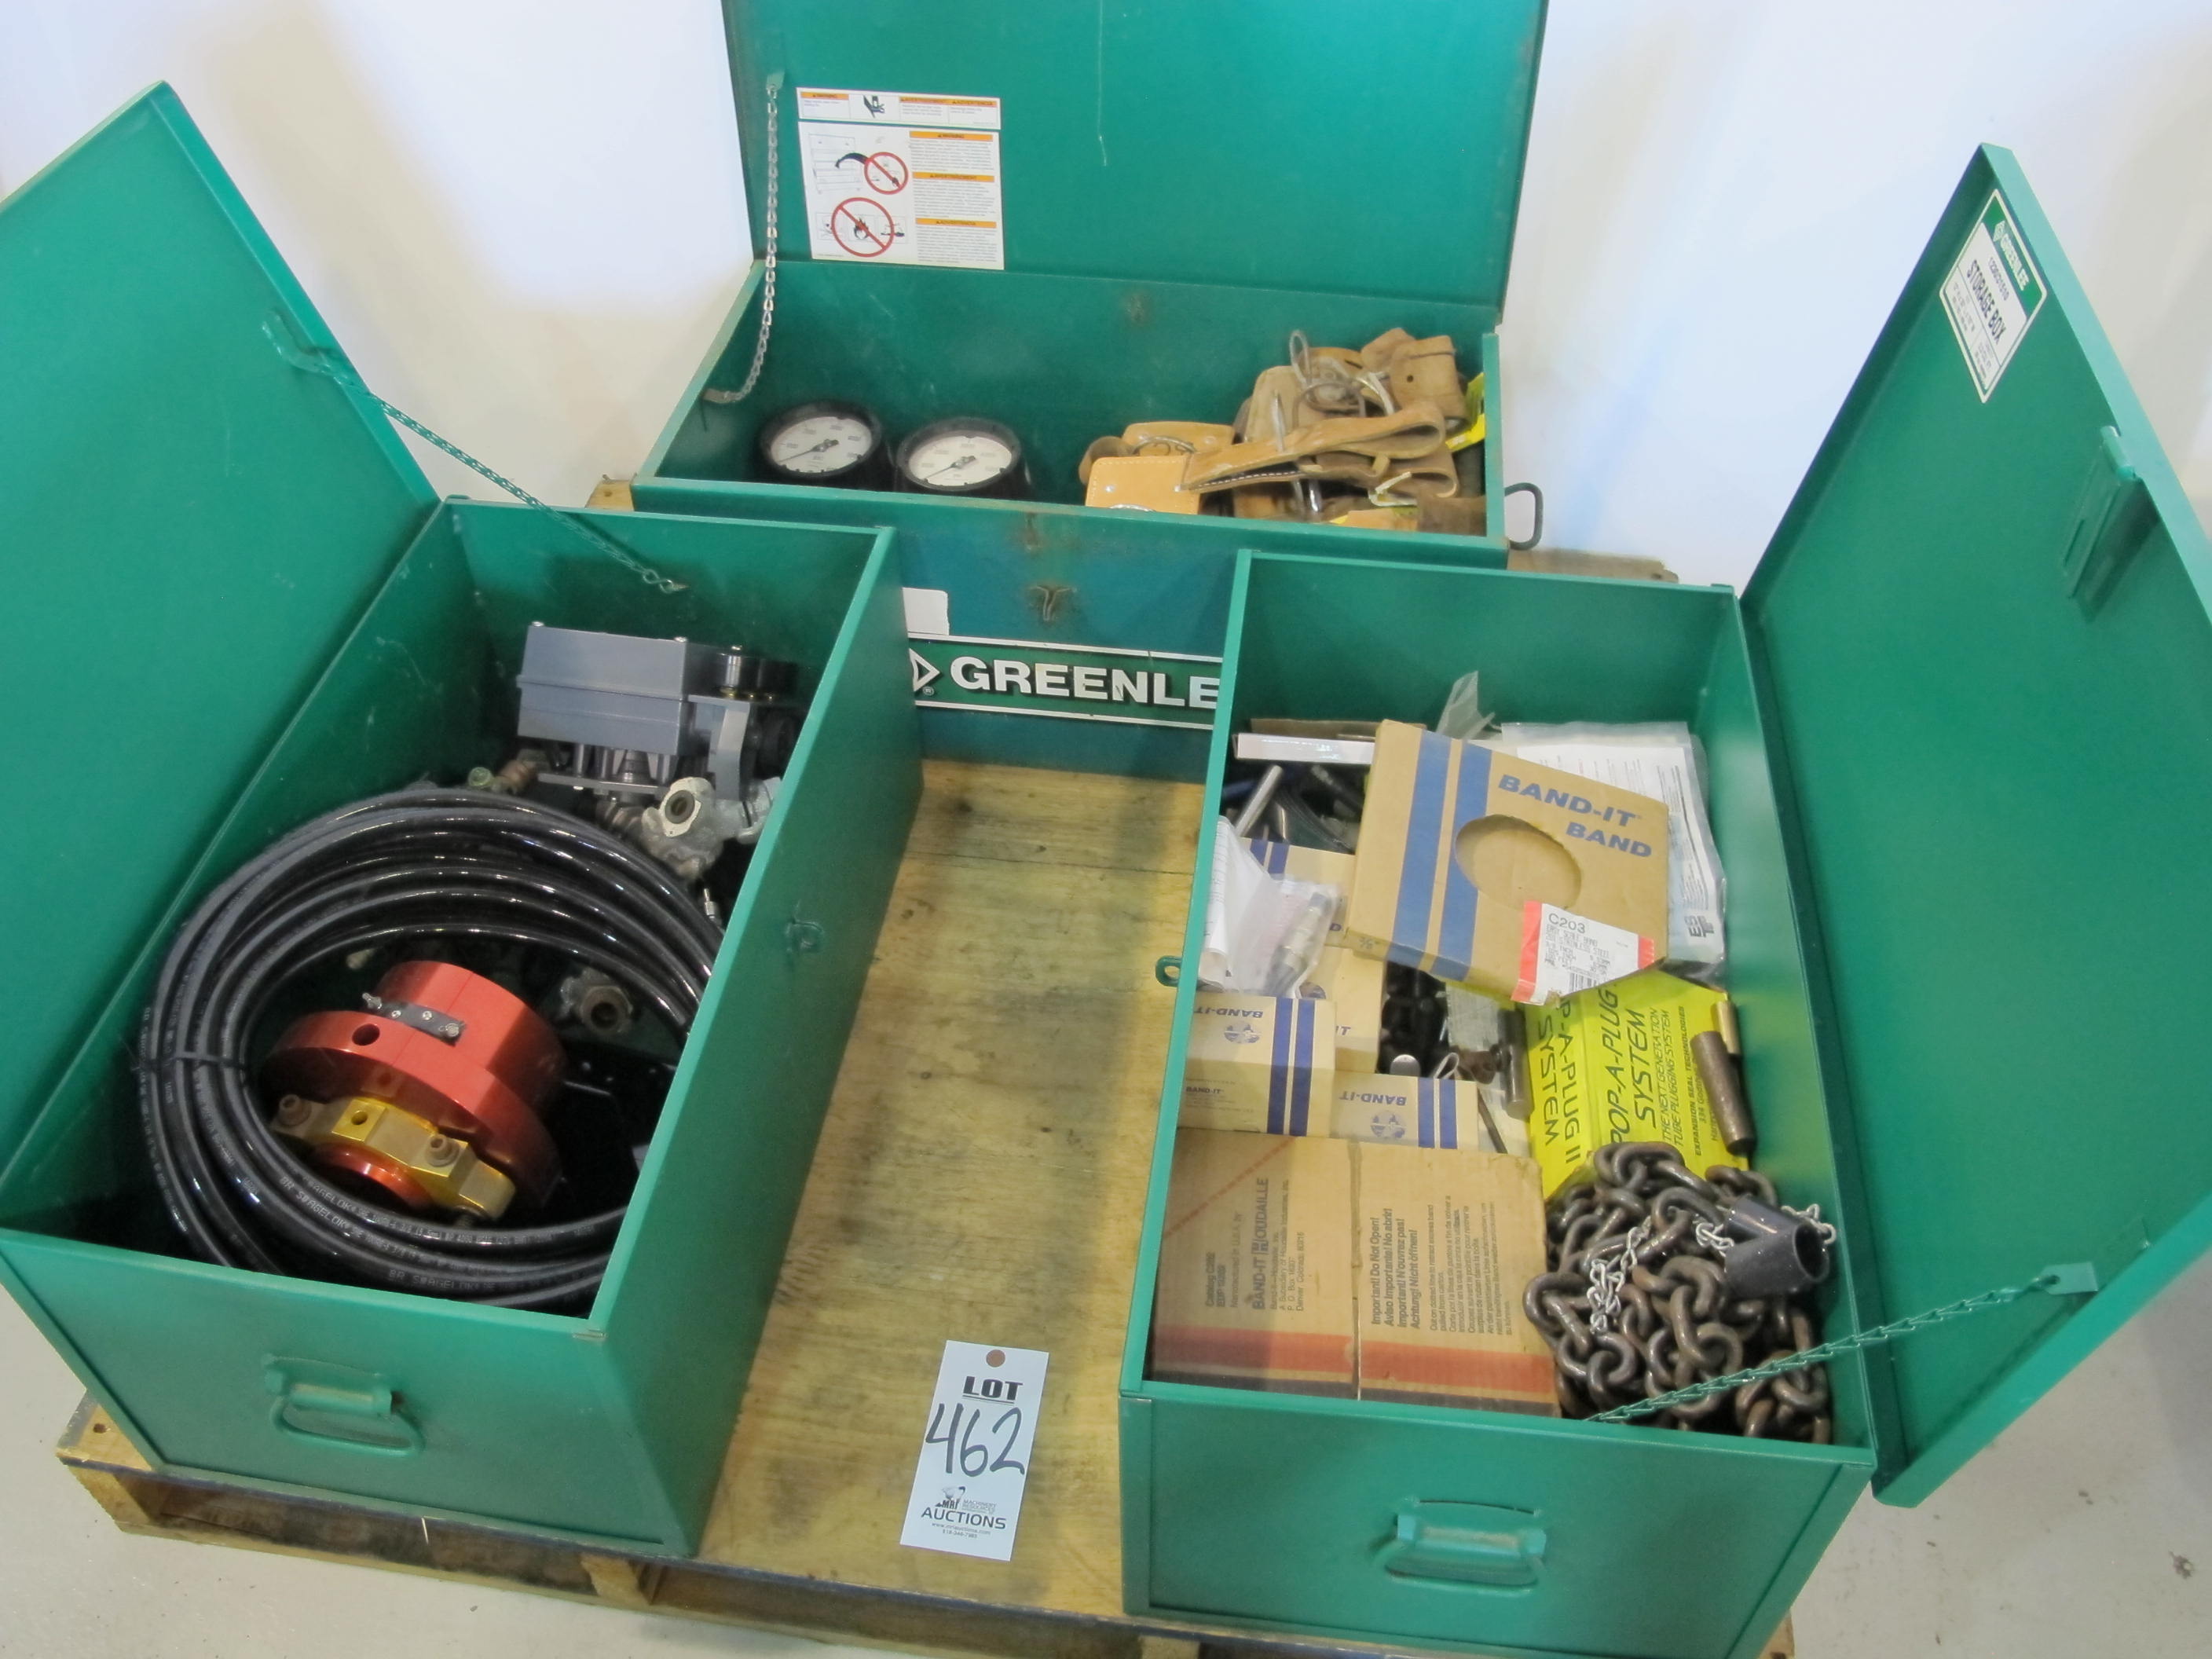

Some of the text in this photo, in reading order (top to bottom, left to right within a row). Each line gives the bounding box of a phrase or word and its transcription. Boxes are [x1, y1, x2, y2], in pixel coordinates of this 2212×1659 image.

[1967, 259, 1995, 317] STORAGE
[1988, 309, 2007, 344] BOX
[1498, 775, 1637, 826] BAND-IT
[1566, 822, 1652, 857] BAND
[1548, 913, 1585, 934] C203
[1194, 1007, 1263, 1018] BAND-IT
[1186, 1086, 1221, 1094] BAND-IT
[1538, 1015, 1559, 1146] SYSTEM
[1598, 988, 1631, 1144] POP-A-PLUG
[1626, 1008, 1657, 1130] SYSTEM
[1650, 1007, 1672, 1141] THE NEXT GENERATION
[1661, 1009, 1683, 1146] TUBE PLUGGING SYSTEM
[1679, 1005, 1701, 1156] EXPANSION SEAL TECHNOLOGIES
[1339, 1090, 1407, 1106] BAND-IT
[1251, 1177, 1269, 1310] BAND-IT HOUDAILLE
[1395, 1218, 1406, 1238] pas!
[1370, 1218, 1382, 1324] Important! Do Not Open!
[1382, 1208, 1394, 1326] Aviso Importante! No abrir!
[1409, 1263, 1419, 1287] Nicht
[1397, 1280, 1408, 1328] Important!
[1409, 1288, 1422, 1329] Achtung!
[963, 1375, 1023, 1401] LOT
[925, 1403, 1024, 1477] 462
[921, 1507, 1006, 1529] AUCTIONS
